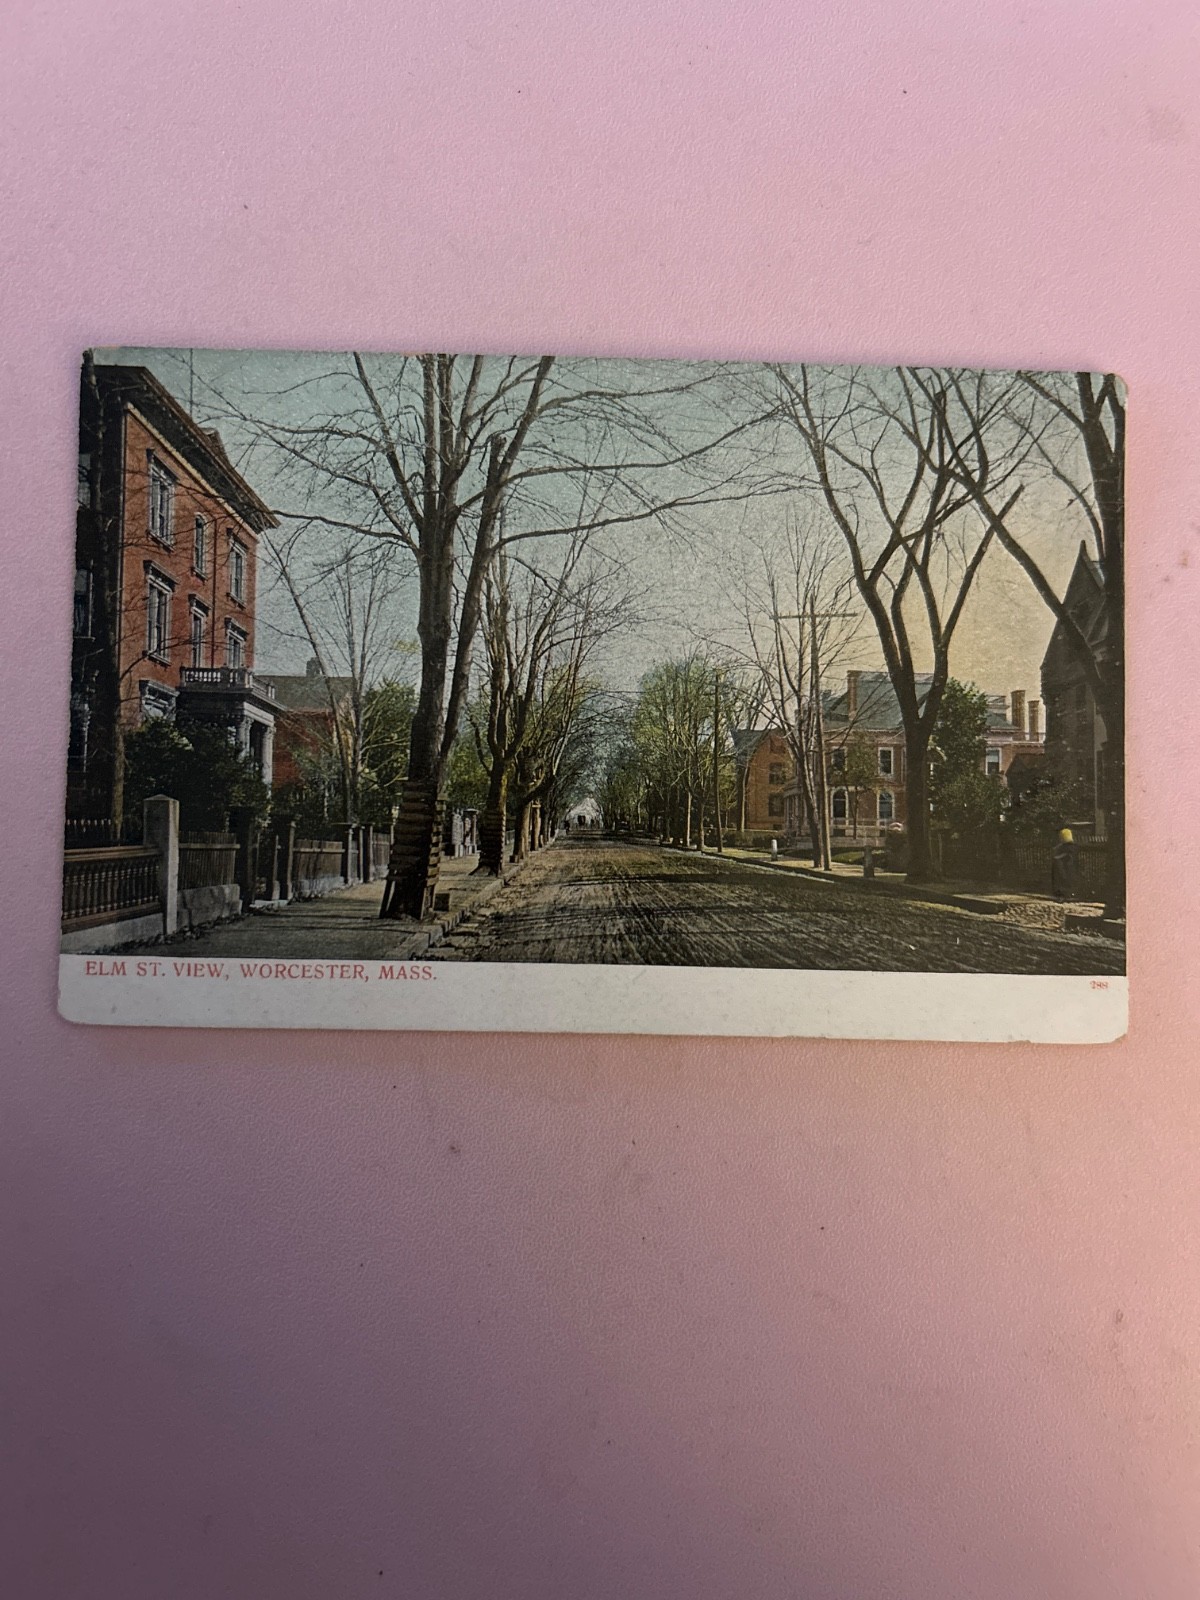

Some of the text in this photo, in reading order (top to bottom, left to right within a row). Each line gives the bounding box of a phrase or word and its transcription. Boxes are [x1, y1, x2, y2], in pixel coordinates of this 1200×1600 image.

[85, 960, 438, 982] ELM ST. VIEW, WORCESTER, MASS.
